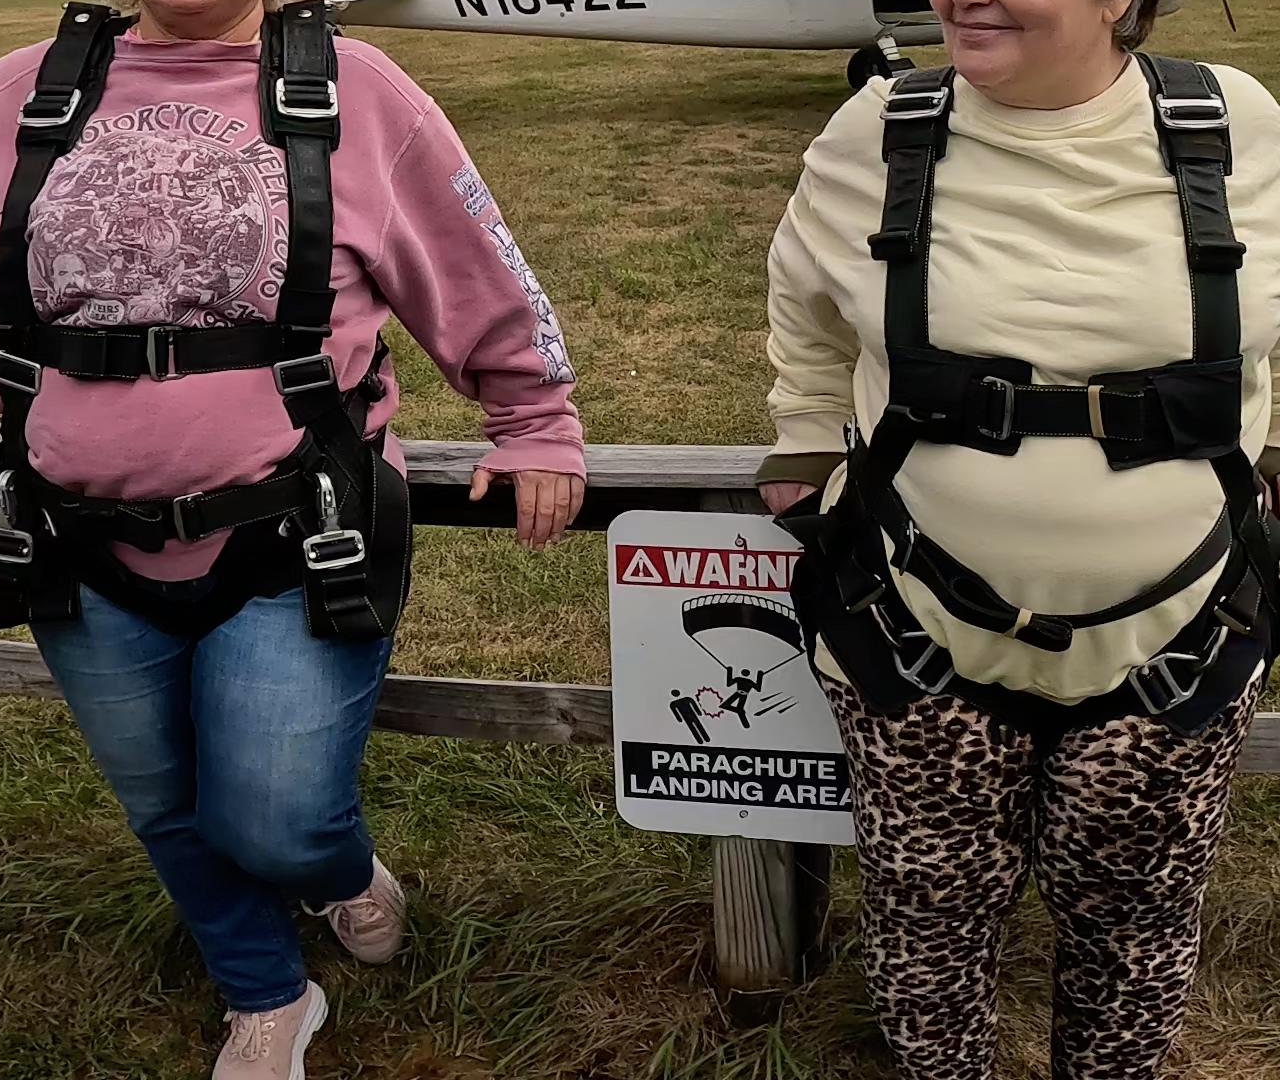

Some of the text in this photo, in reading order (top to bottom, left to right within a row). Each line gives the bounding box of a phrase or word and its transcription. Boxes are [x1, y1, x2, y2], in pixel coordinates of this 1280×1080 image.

[236, 135, 289, 210] WEEK
[651, 750, 837, 780] PARACHUTE
[629, 773, 764, 802] LANDING
